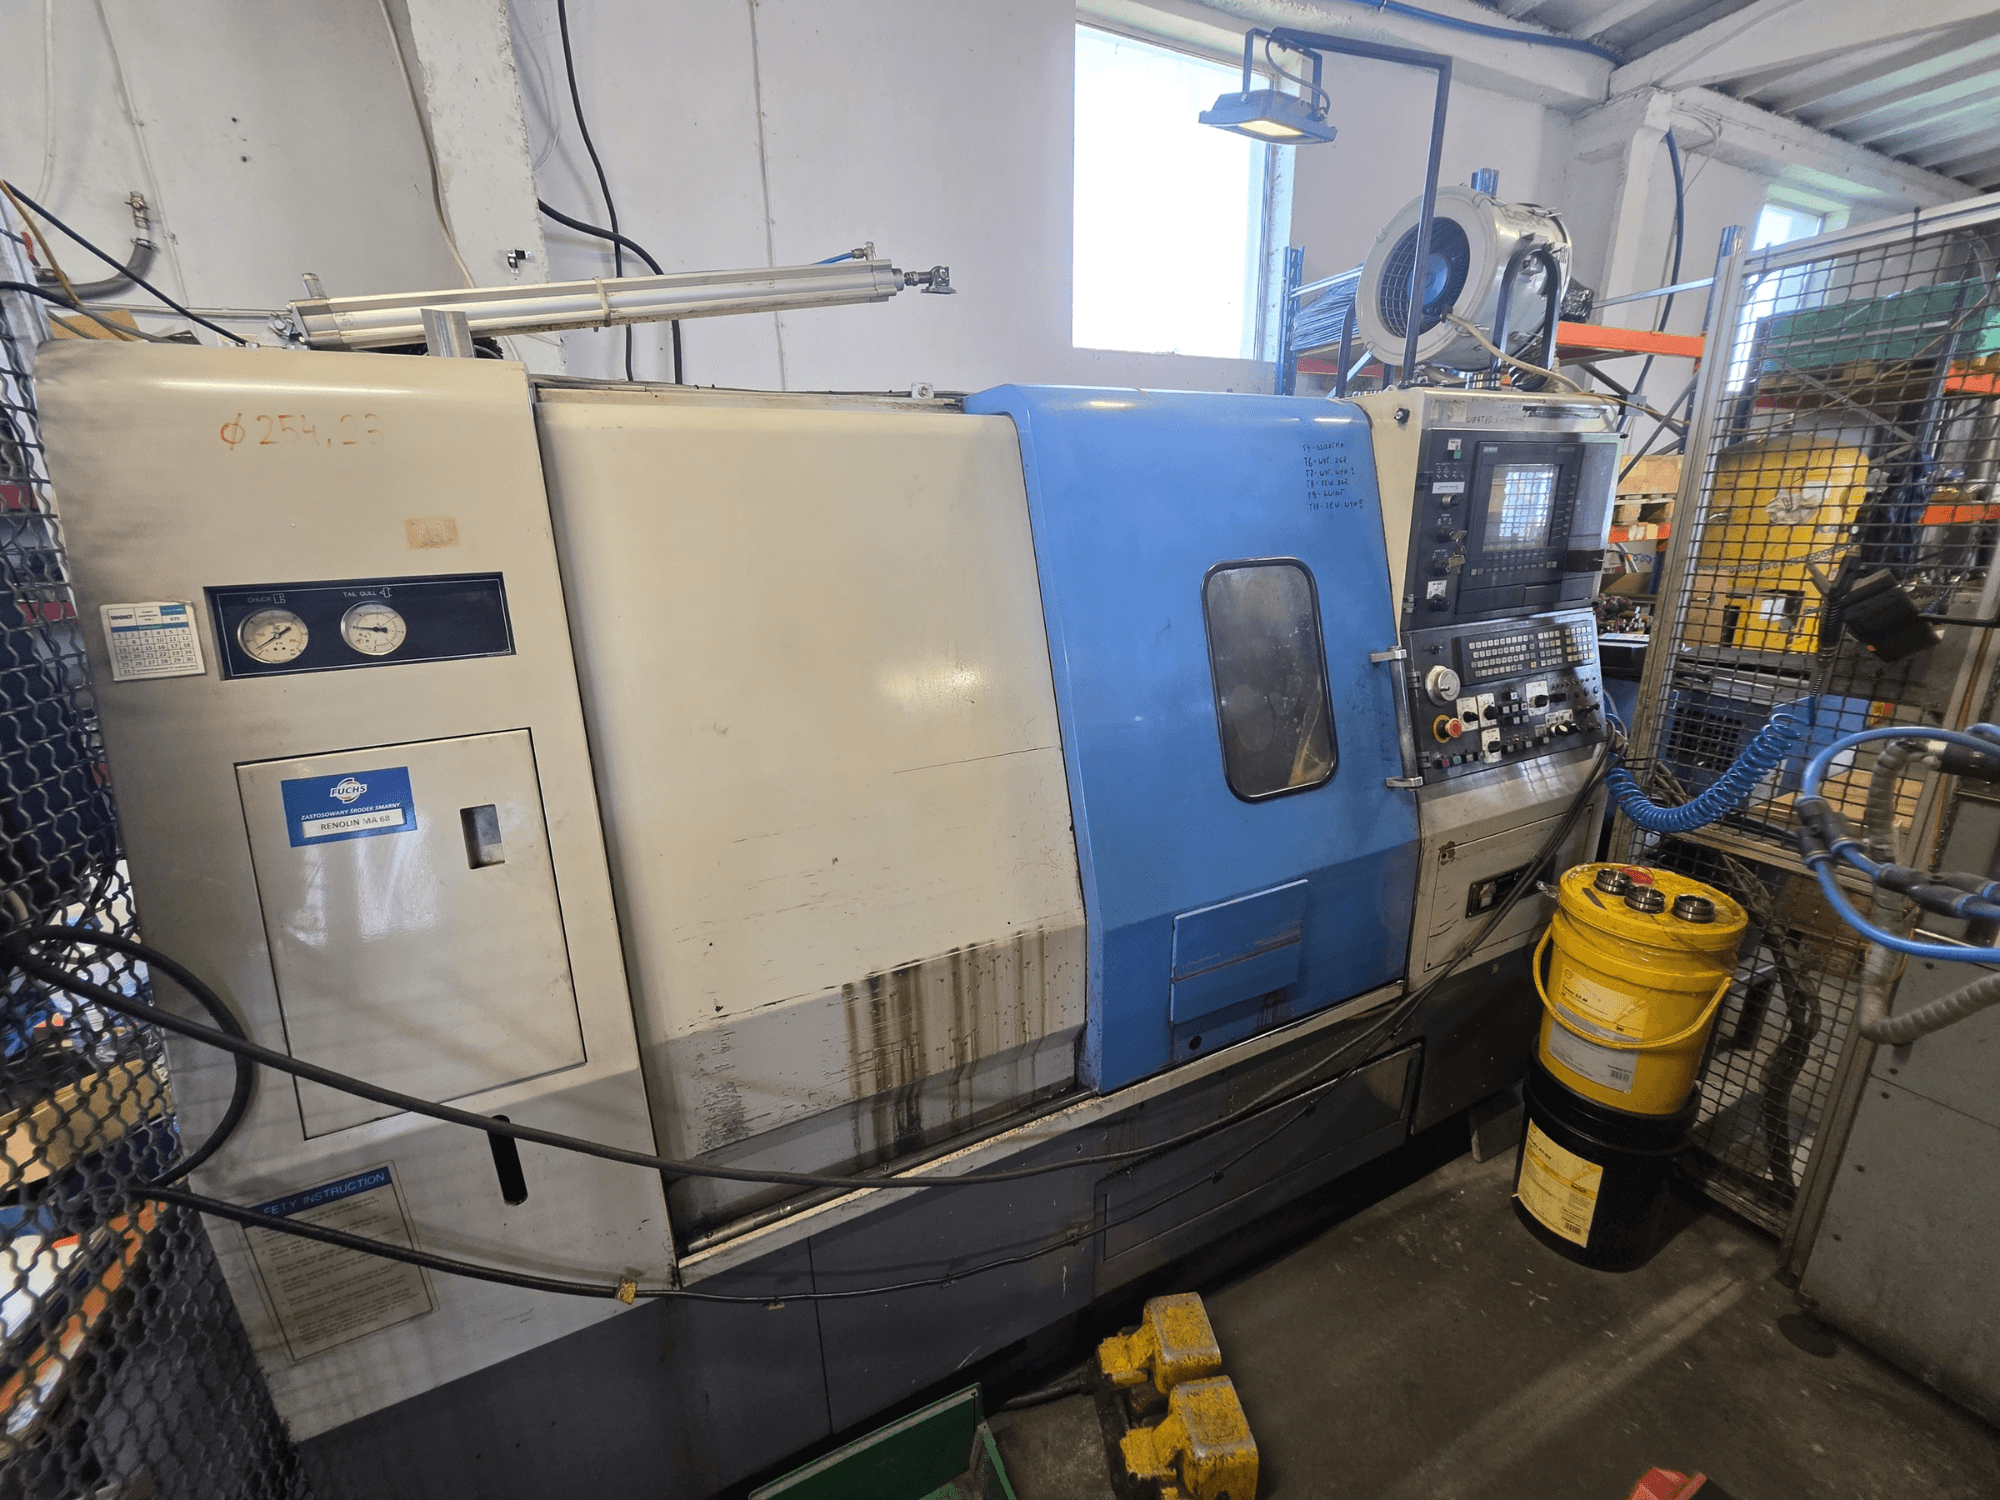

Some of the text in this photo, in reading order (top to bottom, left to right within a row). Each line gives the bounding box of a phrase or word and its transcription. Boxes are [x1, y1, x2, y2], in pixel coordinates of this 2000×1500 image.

[331, 784, 367, 796] FUCHS
[300, 802, 401, 820] ZASTOSOWANY ŚRODEK SMARNY
[320, 815, 391, 830] RENOLIN MA 68
[263, 1172, 385, 1215] FETY INSTRUCTION
